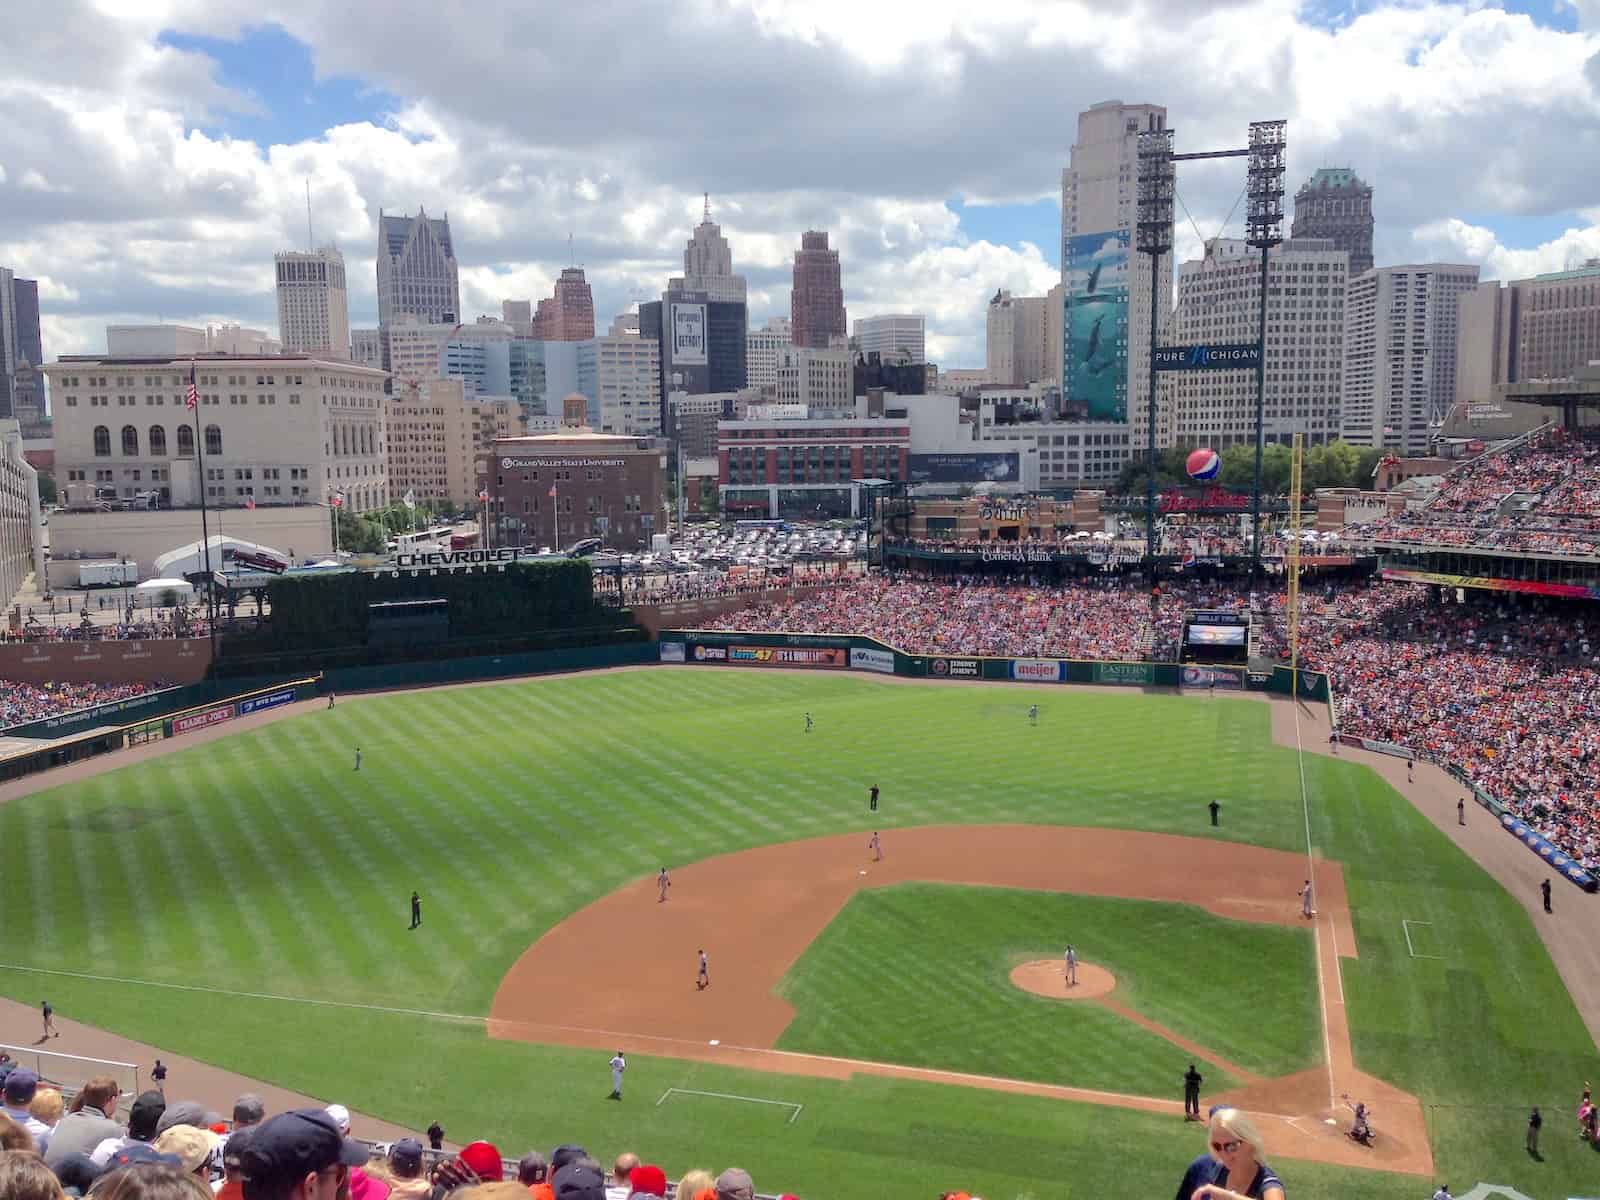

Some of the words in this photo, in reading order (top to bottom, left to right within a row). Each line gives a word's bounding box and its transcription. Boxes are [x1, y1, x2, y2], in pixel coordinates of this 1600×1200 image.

[678, 335, 701, 347] DETROIT
[1155, 351, 1185, 361] PURE
[1191, 345, 1259, 365] MICHIGAN
[397, 549, 521, 566] CHEVROLET
[1028, 550, 1053, 562] Bank
[1018, 663, 1056, 678] meijer
[1099, 663, 1147, 674] EASTERN
[179, 716, 208, 730] TRADER
